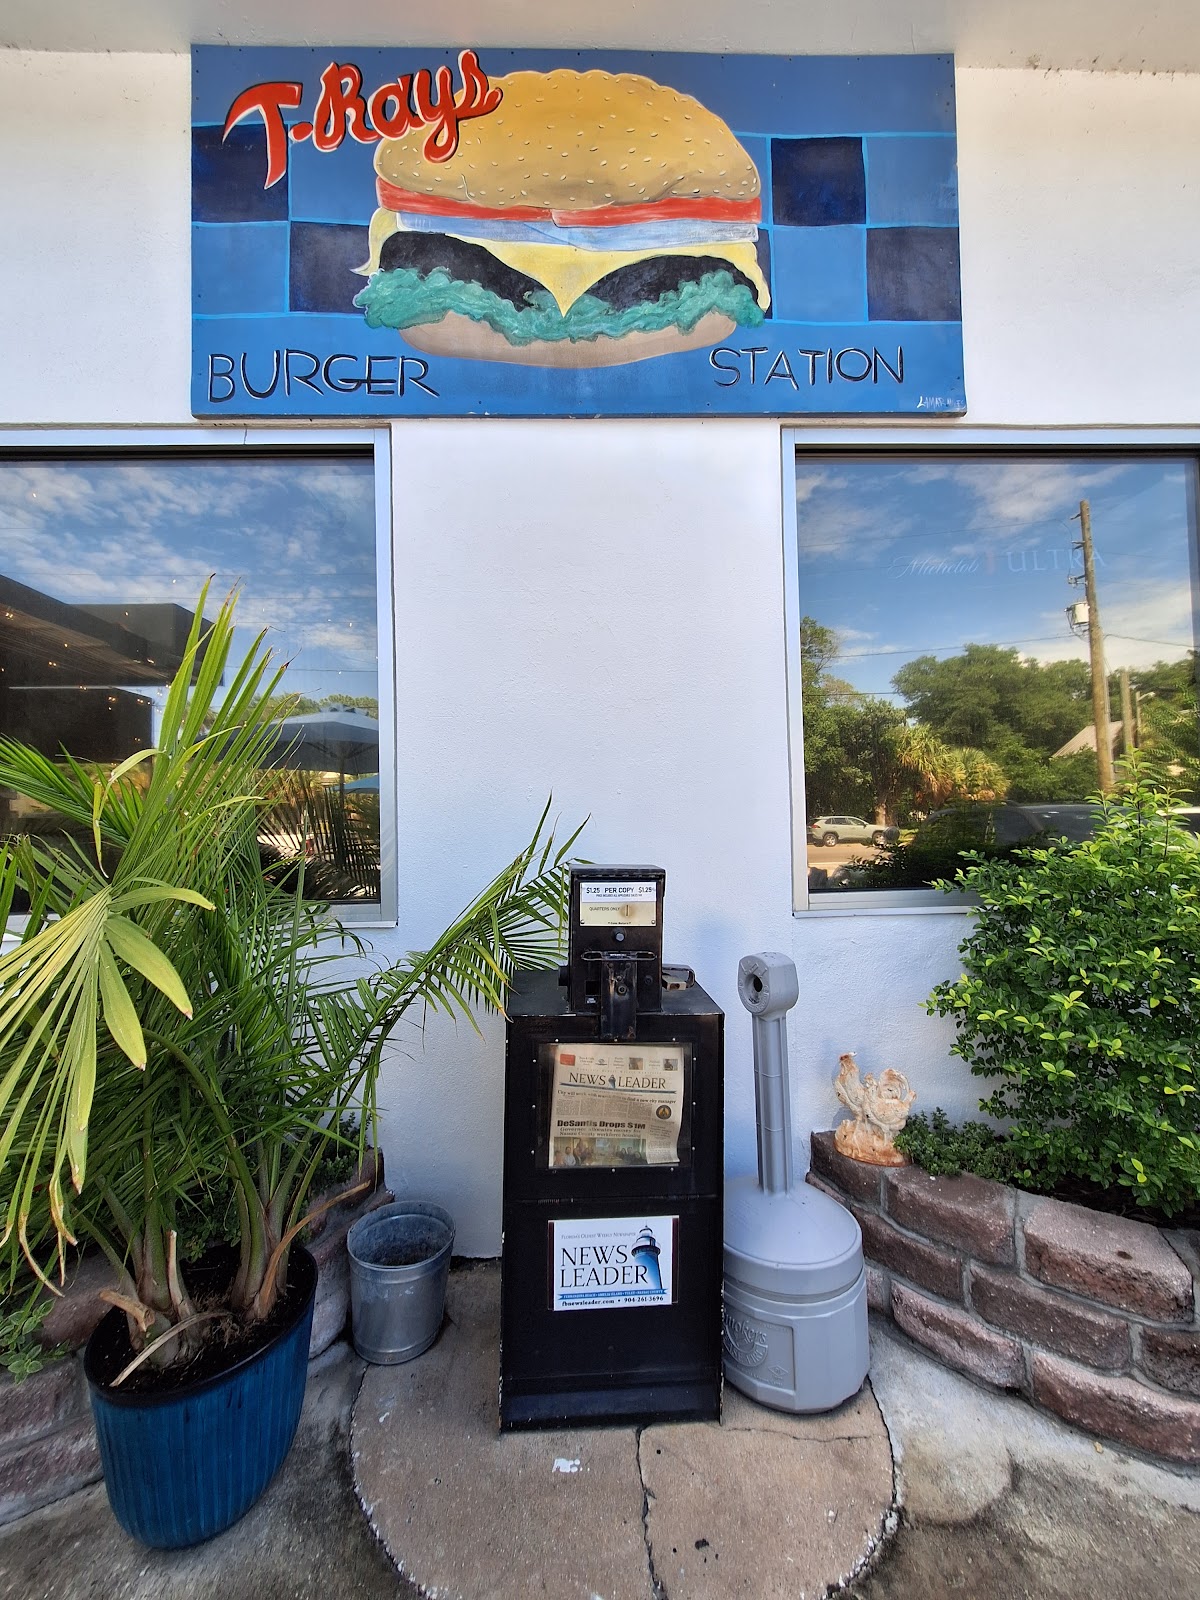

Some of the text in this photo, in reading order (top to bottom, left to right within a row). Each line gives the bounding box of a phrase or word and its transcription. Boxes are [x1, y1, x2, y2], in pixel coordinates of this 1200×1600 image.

[207, 348, 440, 404] BURGER
[709, 345, 904, 391] STATION
[569, 1072, 666, 1089] NEWS LEADER
[627, 1122, 646, 1130] $1M
[561, 1244, 628, 1267] NEWS
[561, 1265, 648, 1288] LEADER
